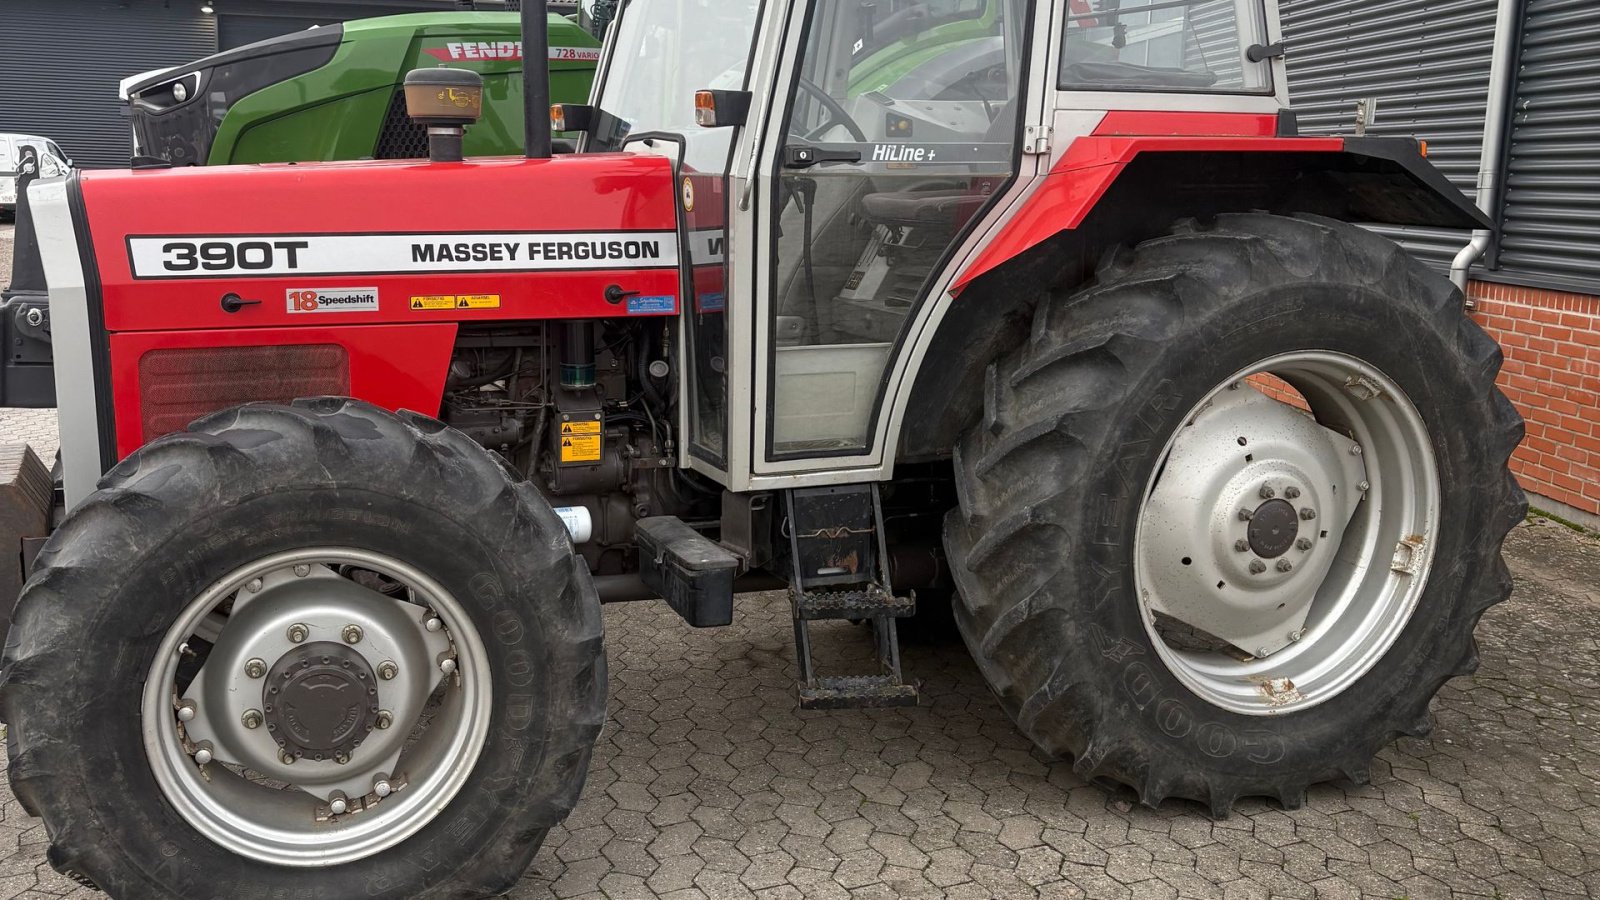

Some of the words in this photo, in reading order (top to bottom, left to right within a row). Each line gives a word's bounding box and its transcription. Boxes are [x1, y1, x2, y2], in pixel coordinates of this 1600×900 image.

[555, 48, 576, 59] 728
[577, 51, 599, 59] VARIO
[872, 144, 925, 161] HiLine
[162, 241, 309, 271] 390T
[411, 242, 521, 263] MASSEY
[528, 240, 660, 261] FERGUSON
[288, 290, 319, 312] 18
[318, 294, 375, 306] Speedshift
